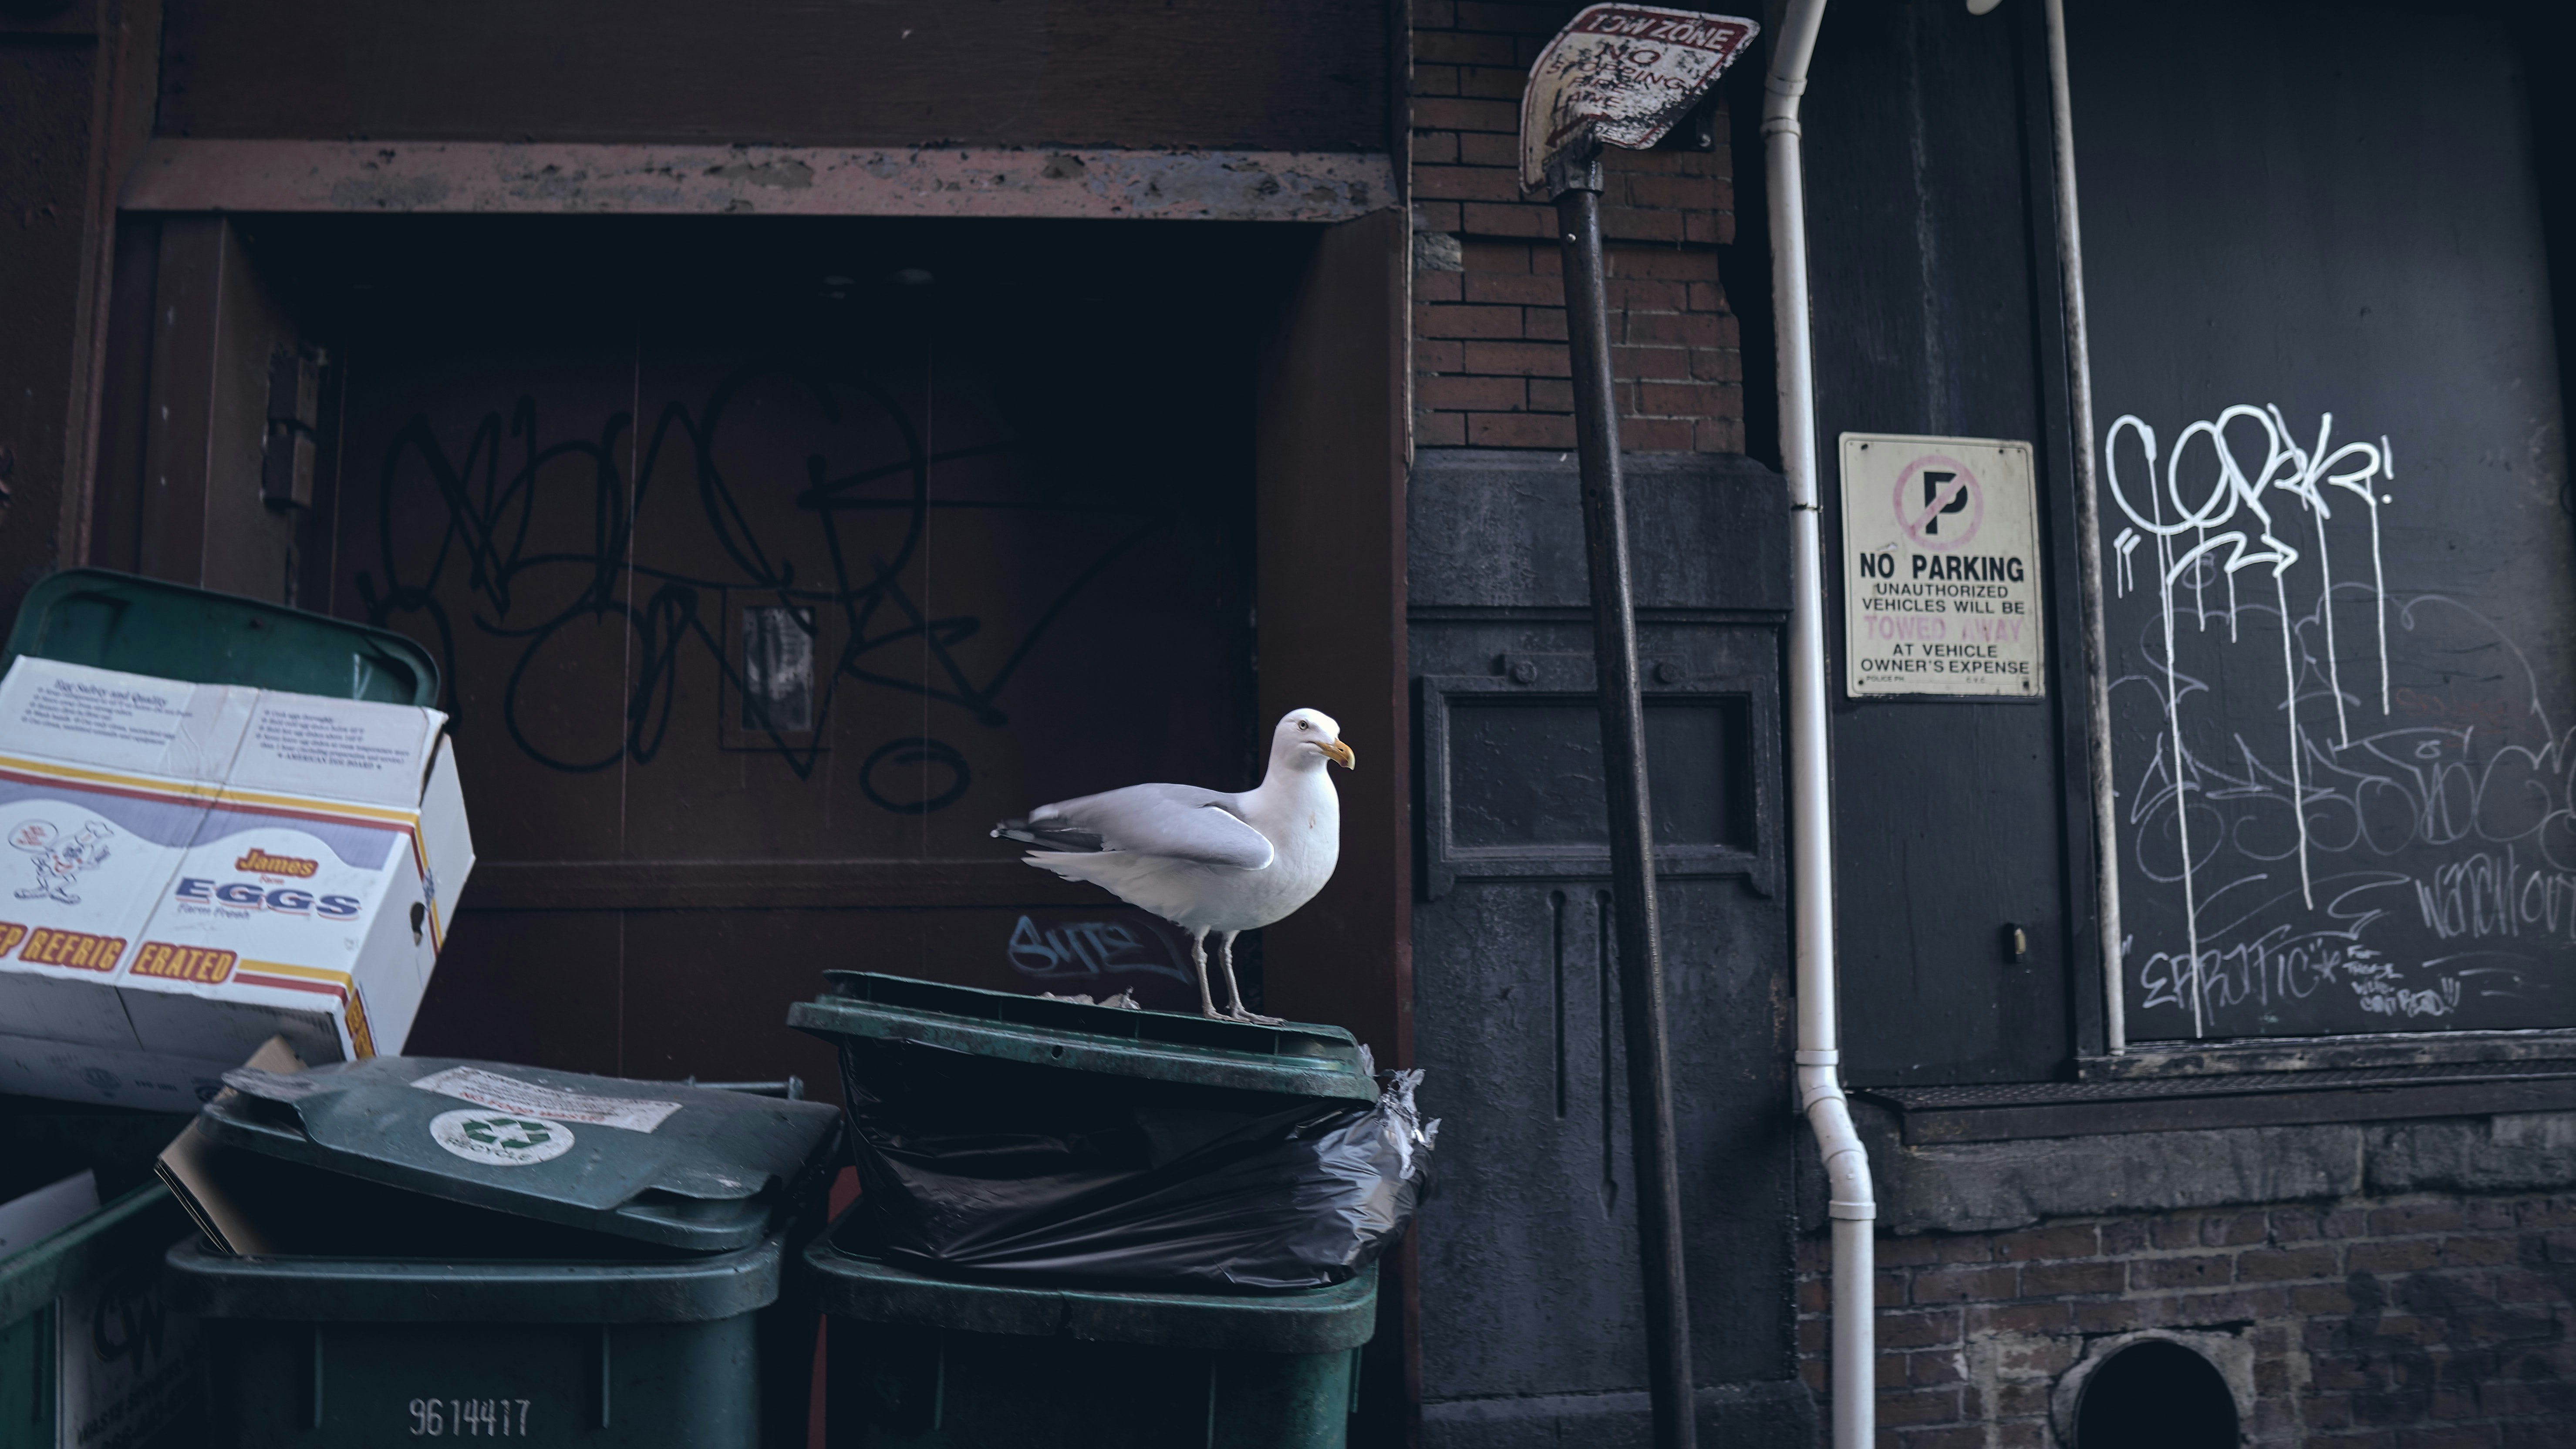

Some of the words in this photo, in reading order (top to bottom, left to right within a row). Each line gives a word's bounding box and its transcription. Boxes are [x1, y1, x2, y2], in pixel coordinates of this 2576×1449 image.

[1587, 13, 1657, 34] TOW
[1653, 20, 1736, 51] ZONE
[1597, 42, 1661, 64] NO
[1860, 553, 1895, 578] NO
[1912, 555, 2024, 583] PARKING
[1876, 583, 2008, 598] UNAUTHORIZED
[1862, 598, 1946, 613] VEHICLES
[1954, 601, 1995, 613] WILL
[2002, 603, 2024, 614] BE
[1864, 615, 1946, 640] TOWED
[1962, 618, 2023, 642] AWAY
[1893, 644, 1914, 656] AT
[1922, 644, 1998, 658] VEHICLE
[1861, 658, 1944, 673] OWNER'S
[1949, 660, 2030, 674] EXPENSE
[238, 849, 317, 877] James
[175, 877, 361, 920] EGGS
[409, 1398, 531, 1437] 9614417
